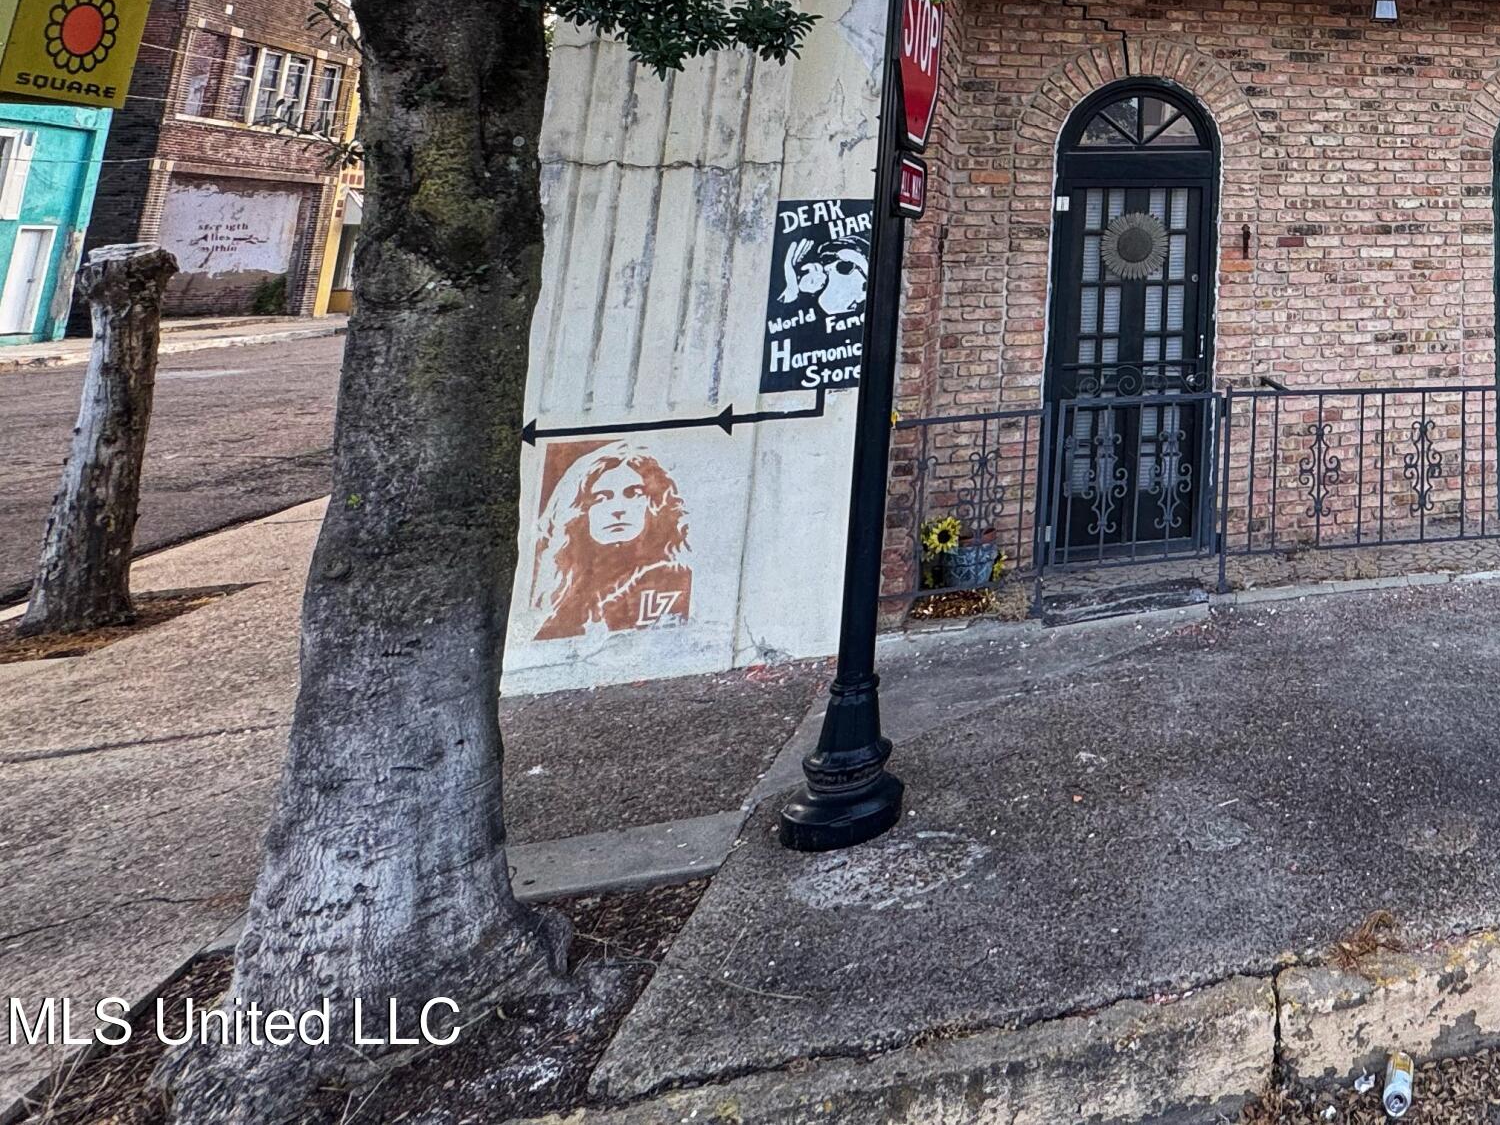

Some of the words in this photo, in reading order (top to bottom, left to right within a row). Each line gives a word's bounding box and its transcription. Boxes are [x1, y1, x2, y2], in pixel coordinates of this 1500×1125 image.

[15, 72, 117, 99] SQUARE
[900, 170, 911, 197] ALL
[911, 174, 922, 200] WAY
[779, 199, 845, 234] DEAK
[828, 210, 873, 240] HAR
[768, 308, 817, 334] World
[801, 365, 861, 388] Store
